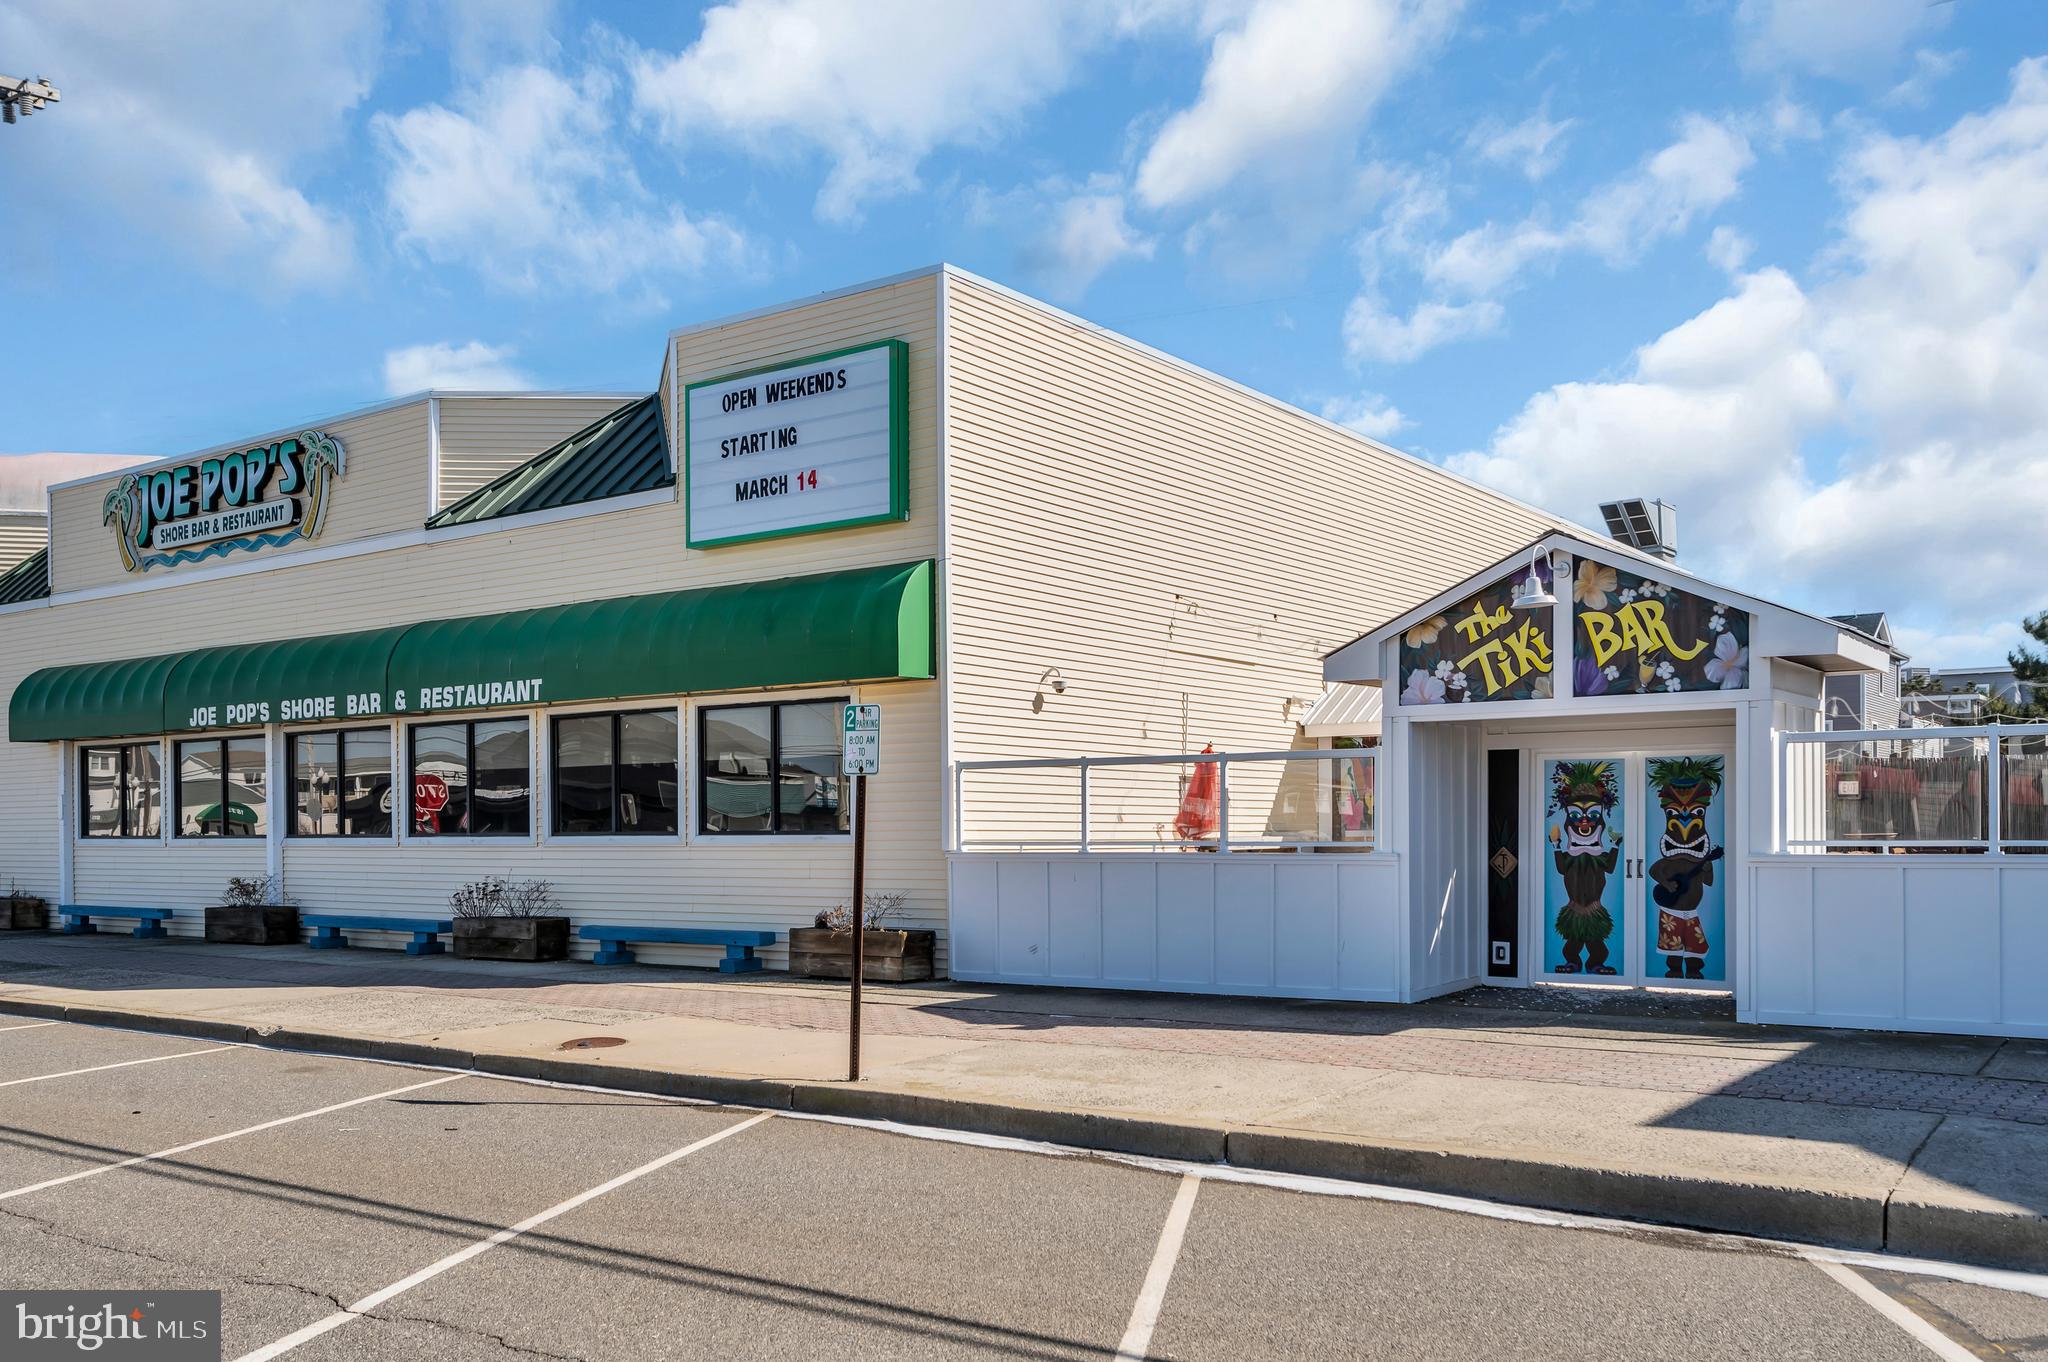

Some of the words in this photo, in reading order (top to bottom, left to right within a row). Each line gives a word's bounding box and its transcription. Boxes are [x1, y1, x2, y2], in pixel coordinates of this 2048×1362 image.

[722, 387, 757, 413] OPEN
[765, 369, 847, 404] WEEKENDS
[720, 426, 798, 458] STARTING
[136, 464, 195, 548] JOE
[201, 438, 303, 512] POP'S
[735, 474, 788, 502] MARCH
[796, 469, 818, 491] 14
[160, 523, 189, 544] SHORE
[191, 519, 210, 539] BAR
[212, 519, 220, 534] &
[222, 504, 285, 532] RESTAURANT
[1454, 600, 1514, 645] The
[1578, 599, 1710, 668] BAR
[189, 706, 217, 728] JOE
[225, 702, 270, 724] POP'S
[280, 696, 336, 721] SHORE
[346, 692, 381, 716] BAR
[394, 689, 407, 711] &
[420, 678, 543, 709] RESTAURANT
[846, 710, 855, 728] 2
[848, 735, 864, 745] 8:00
[865, 735, 876, 745] AM
[856, 719, 878, 729] PARKING
[848, 759, 863, 769] 6:00
[865, 759, 875, 769] PM
[857, 747, 866, 757] TO
